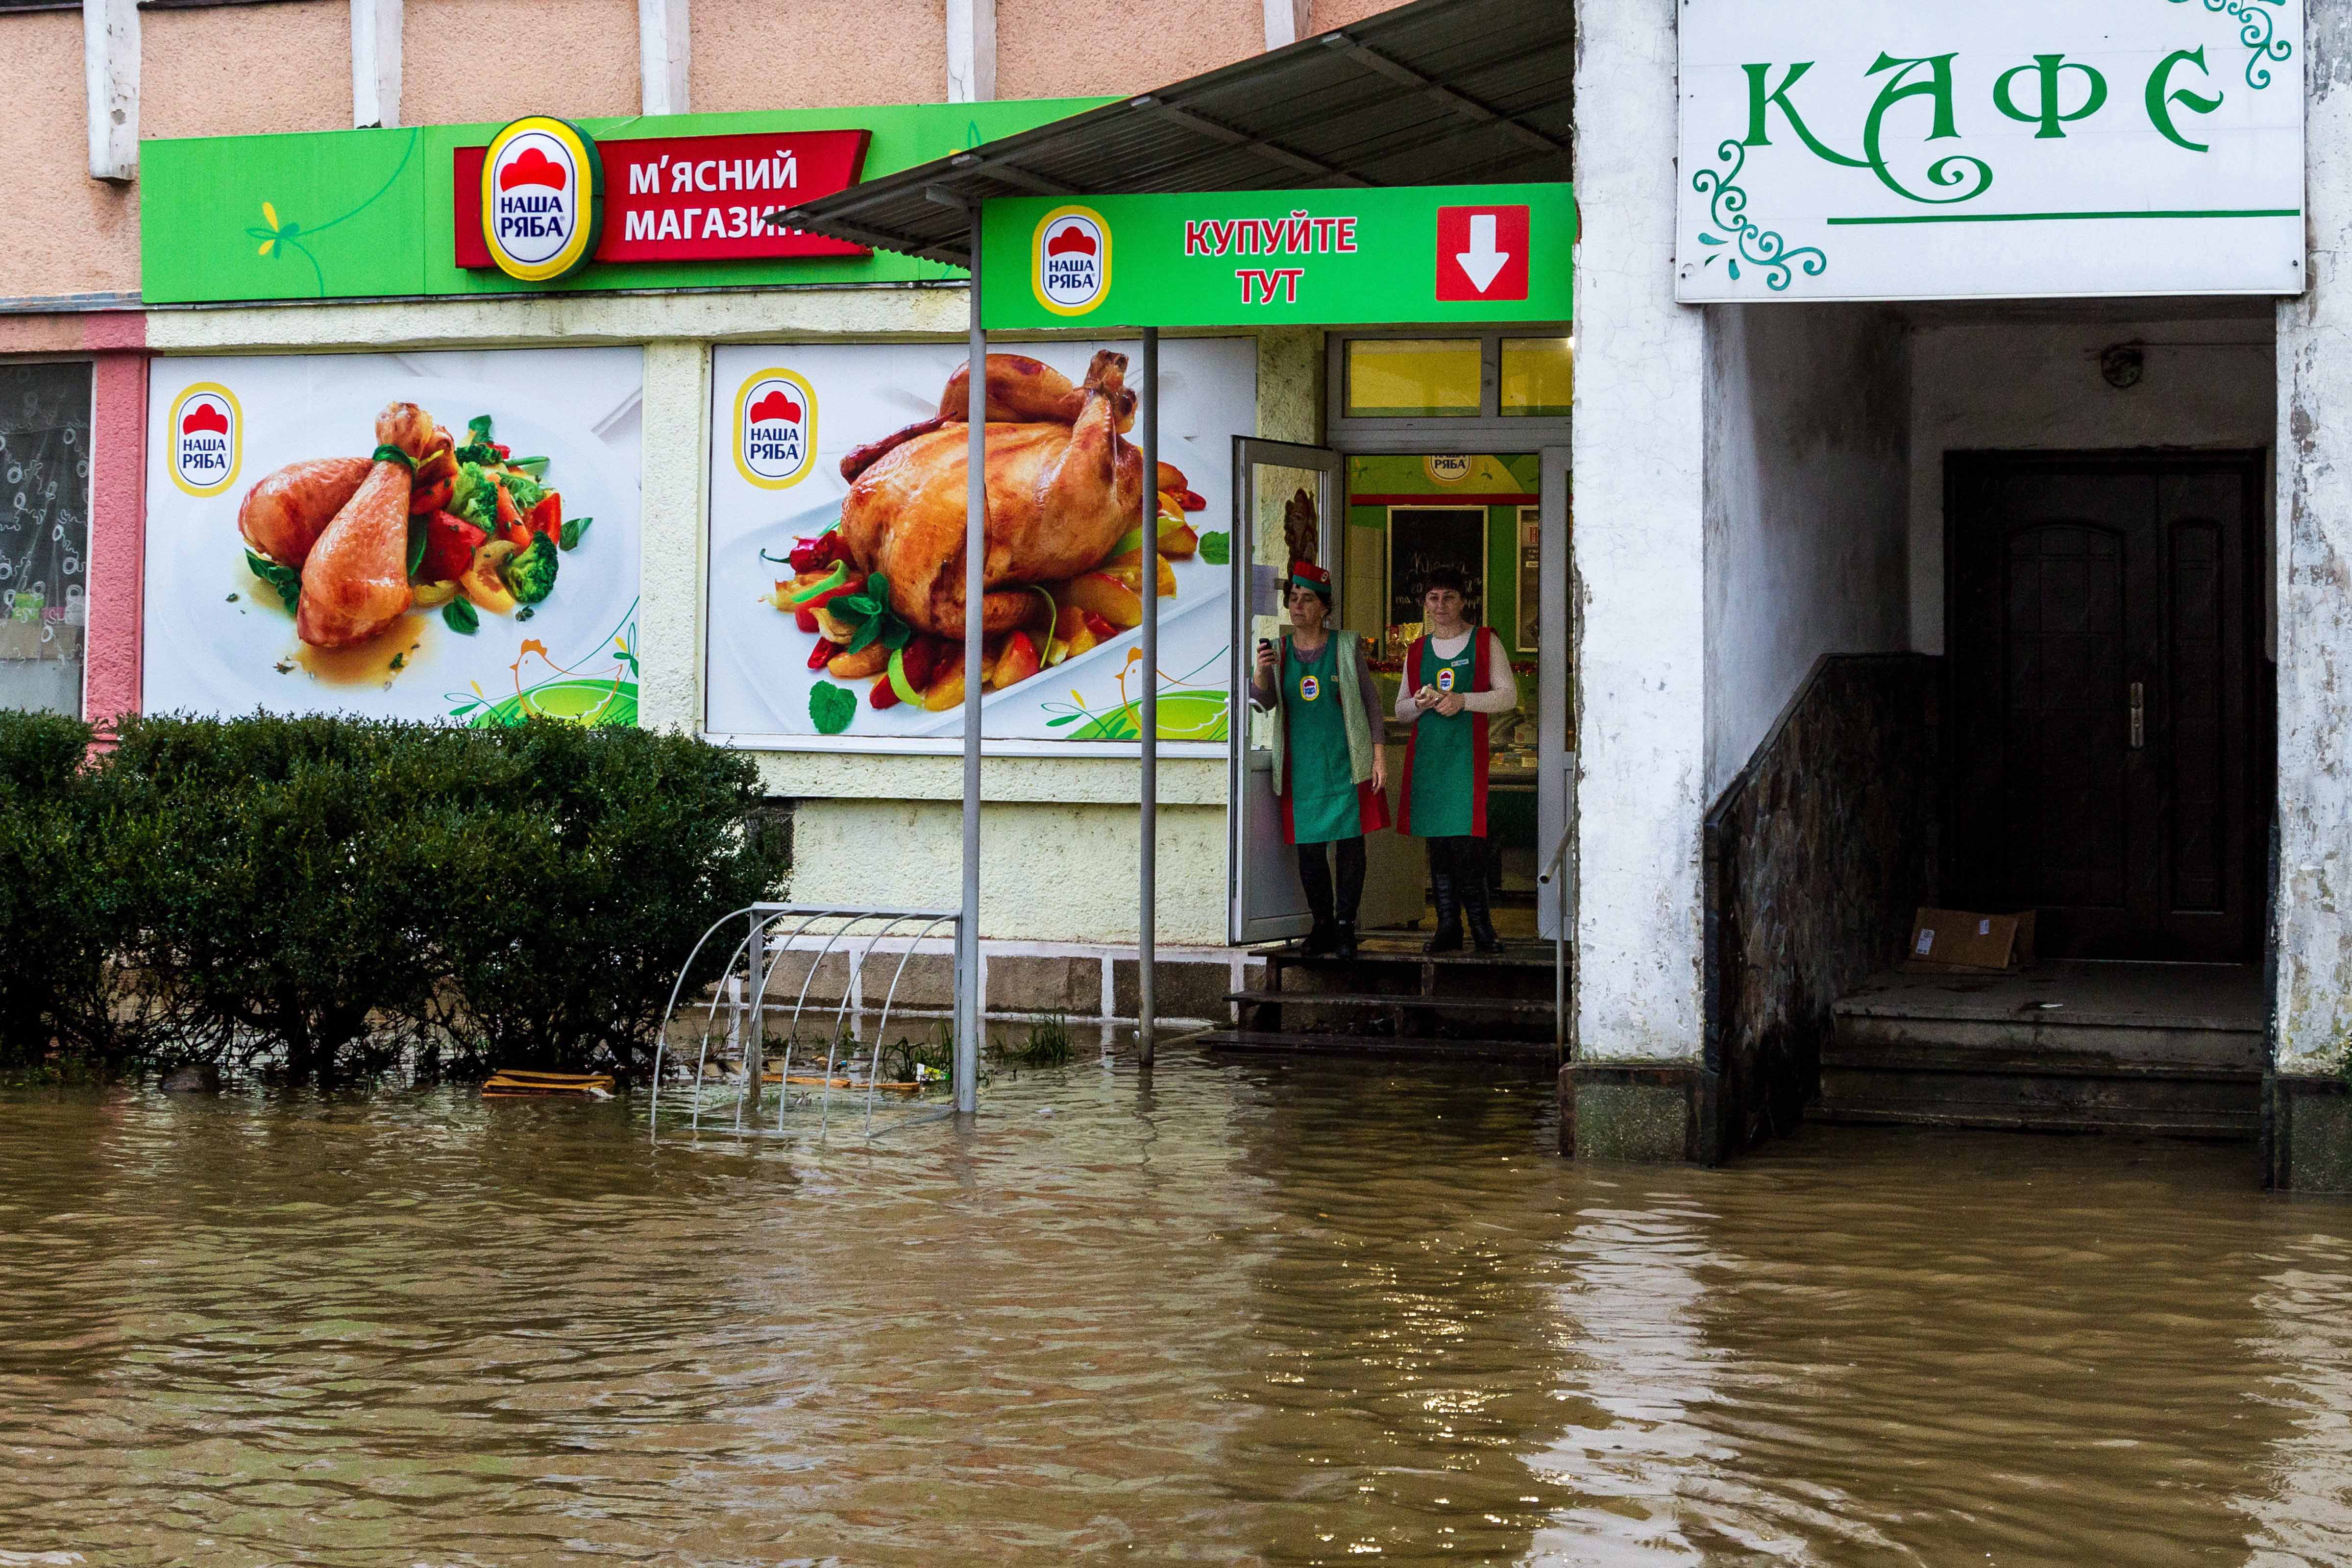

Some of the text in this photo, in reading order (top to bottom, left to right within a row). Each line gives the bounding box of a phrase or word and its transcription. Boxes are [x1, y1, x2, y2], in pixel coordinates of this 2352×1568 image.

[501, 196, 563, 213] НАША
[1185, 209, 1358, 257] КУПУЙТЕ
[1049, 260, 1094, 271] НАША
[1049, 274, 1094, 289] РЯБА
[1235, 268, 1305, 305] ТУТ
[751, 428, 799, 441] НАША
[183, 440, 225, 451] НАША
[750, 443, 799, 460] РЯБА
[183, 454, 225, 468] РЯБА
[1435, 459, 1466, 469] РЯБА
